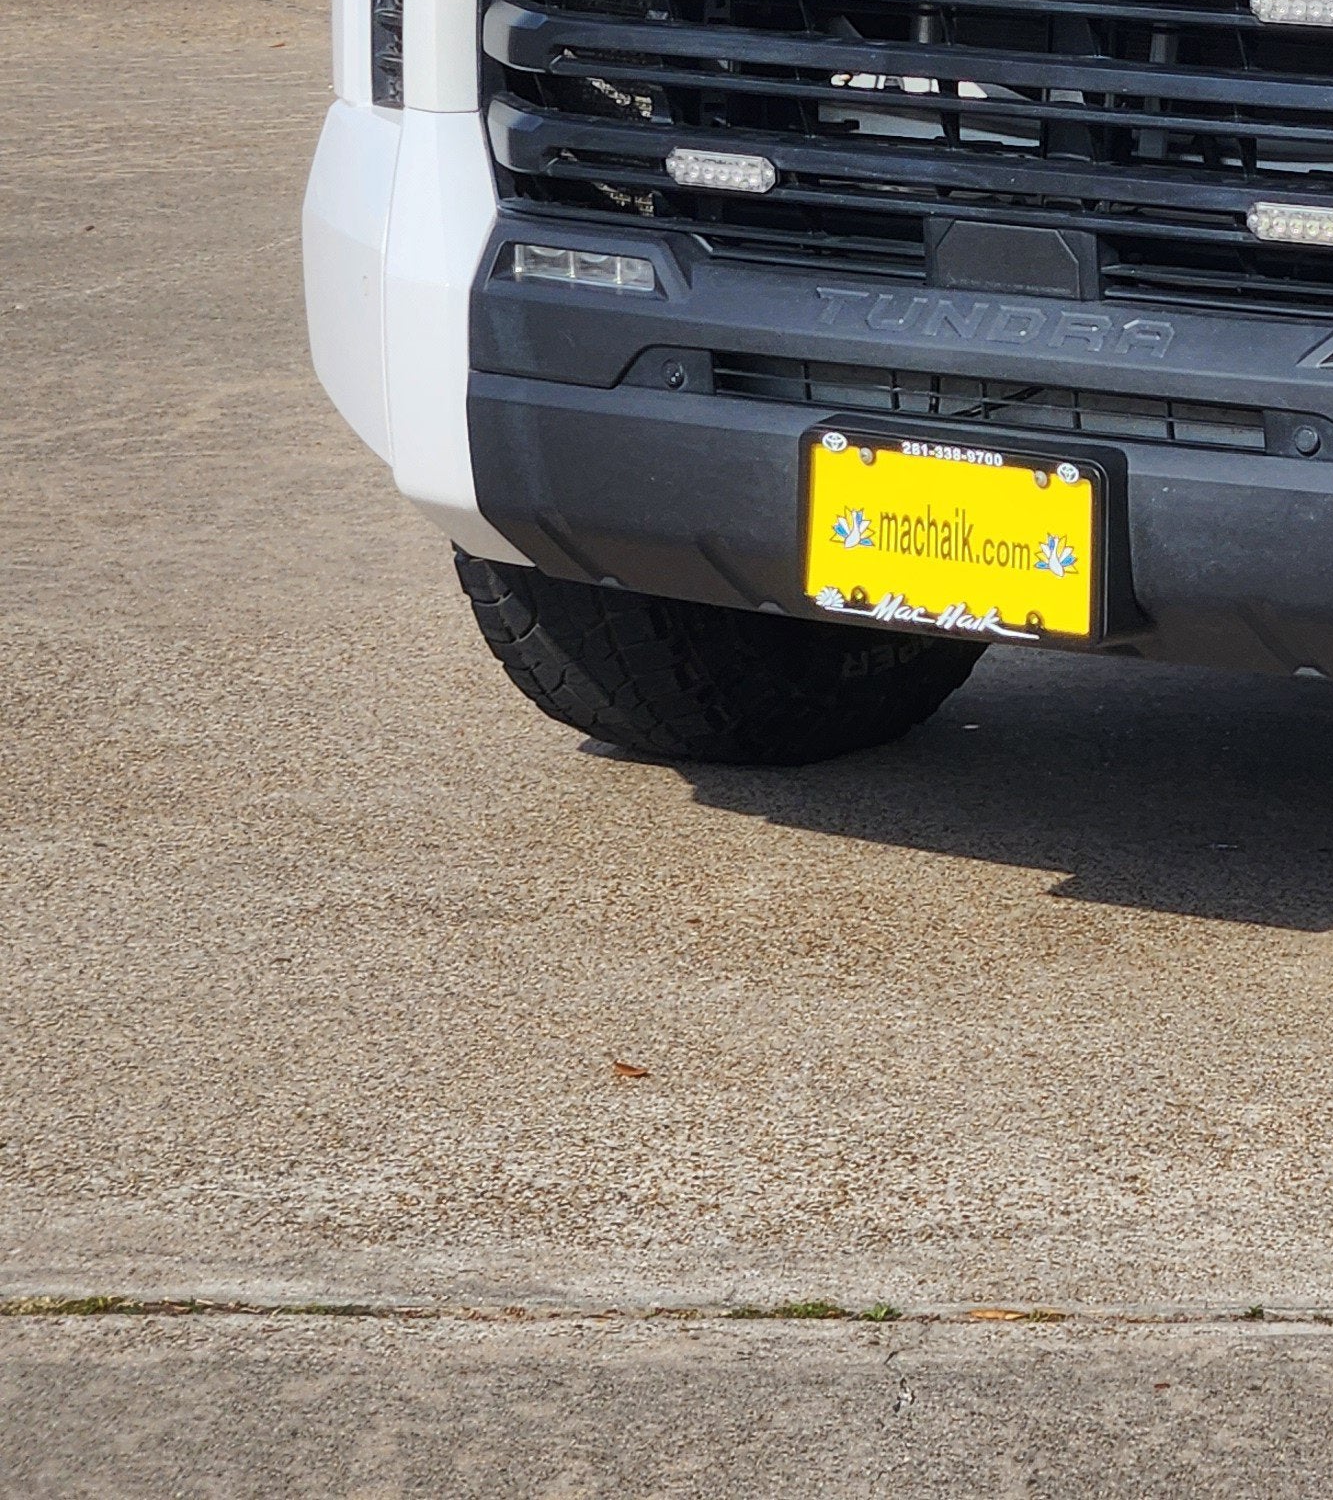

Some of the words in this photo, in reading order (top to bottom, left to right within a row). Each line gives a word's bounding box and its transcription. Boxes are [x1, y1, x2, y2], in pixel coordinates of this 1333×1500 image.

[815, 285, 1175, 359] TUNDRA
[901, 441, 1004, 466] 281-338-9700
[878, 504, 1031, 571] machaik.com
[869, 592, 936, 624] Mac
[932, 602, 1026, 637] Haik
